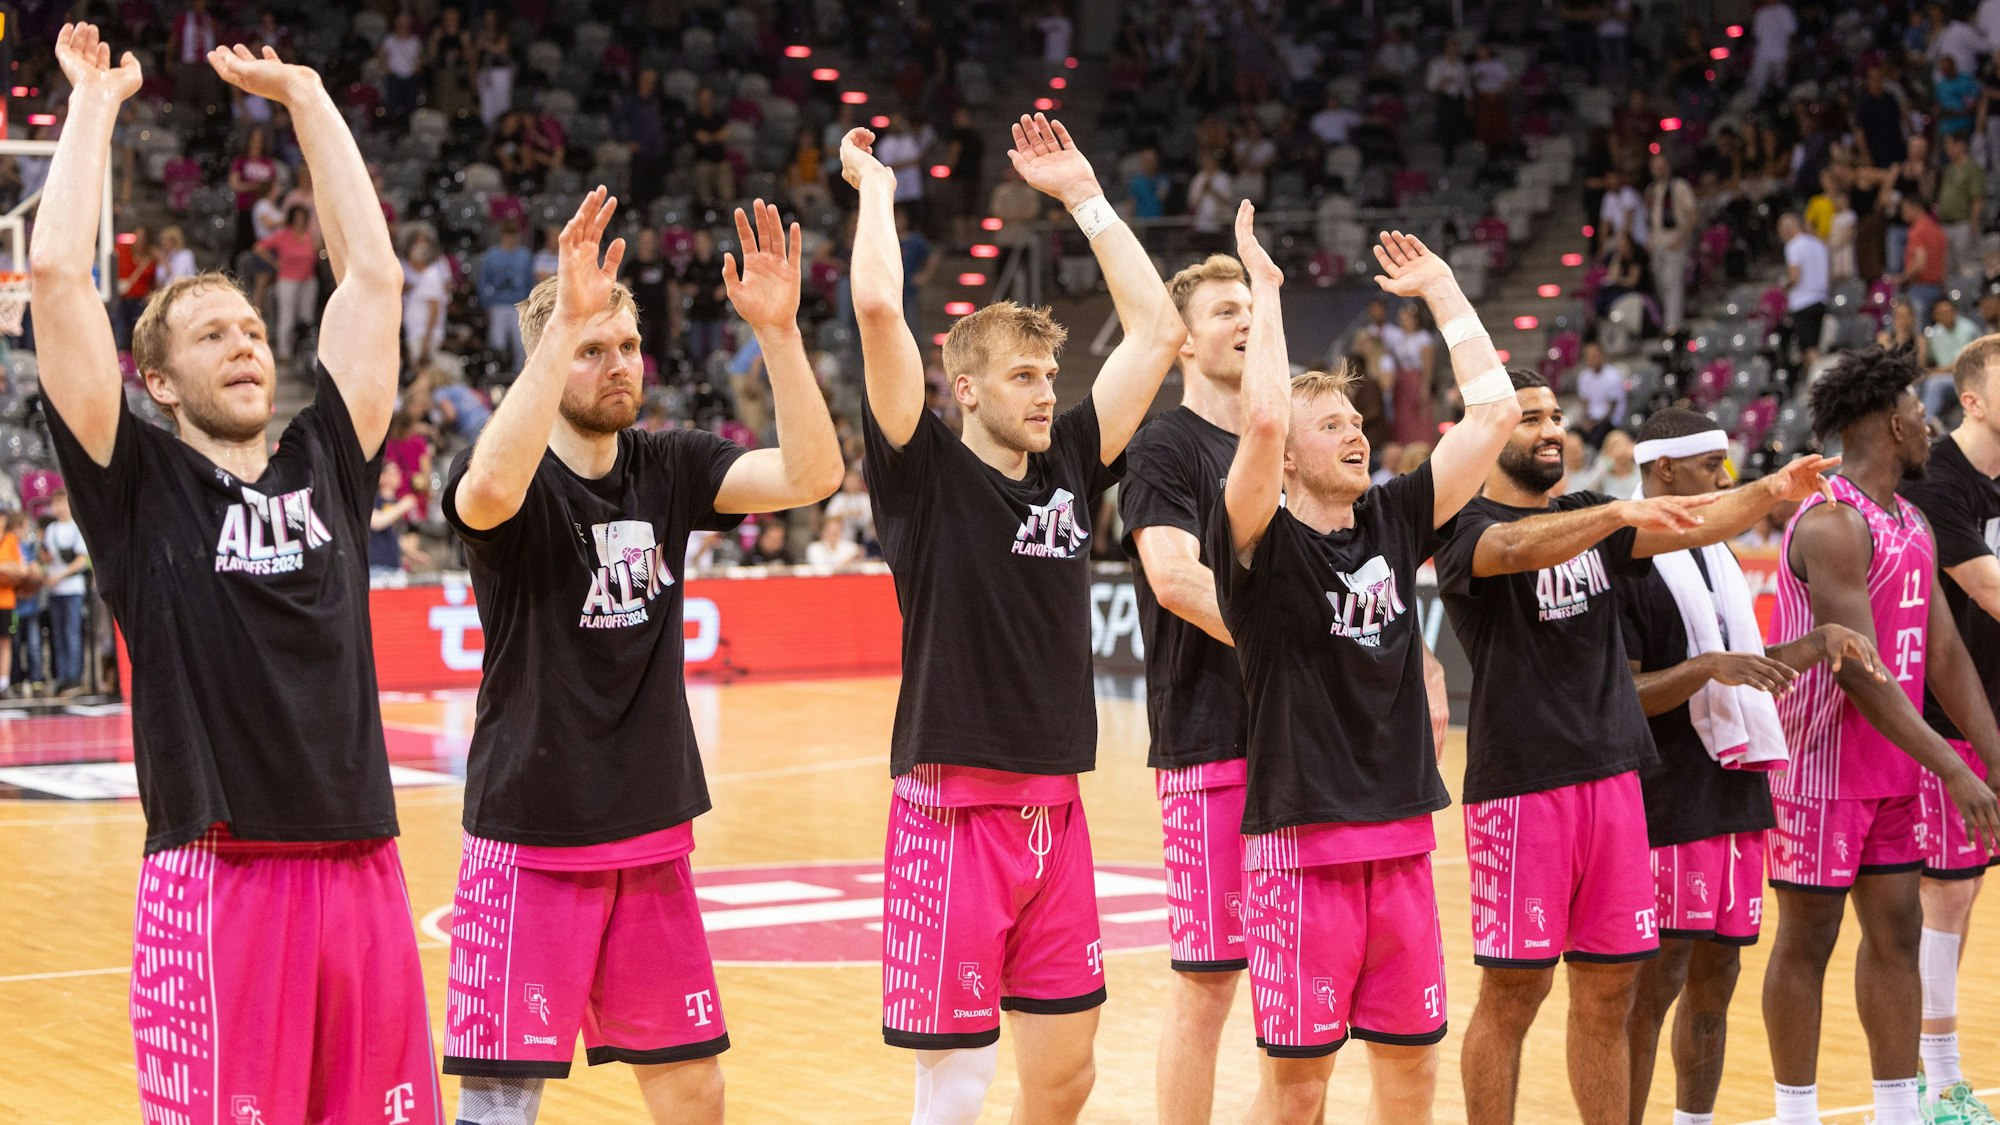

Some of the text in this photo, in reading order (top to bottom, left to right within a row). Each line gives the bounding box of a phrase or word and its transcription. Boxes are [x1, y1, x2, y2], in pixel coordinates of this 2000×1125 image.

[217, 496, 304, 561] ALL
[214, 553, 305, 576] PLAYOFFS 2024
[1536, 562, 1588, 610] ALL
[1899, 568, 1925, 608] 11
[579, 613, 628, 630] PLAYOFFS
[953, 1008, 992, 1018] SPALDING
[524, 1034, 557, 1046] SPALDING
